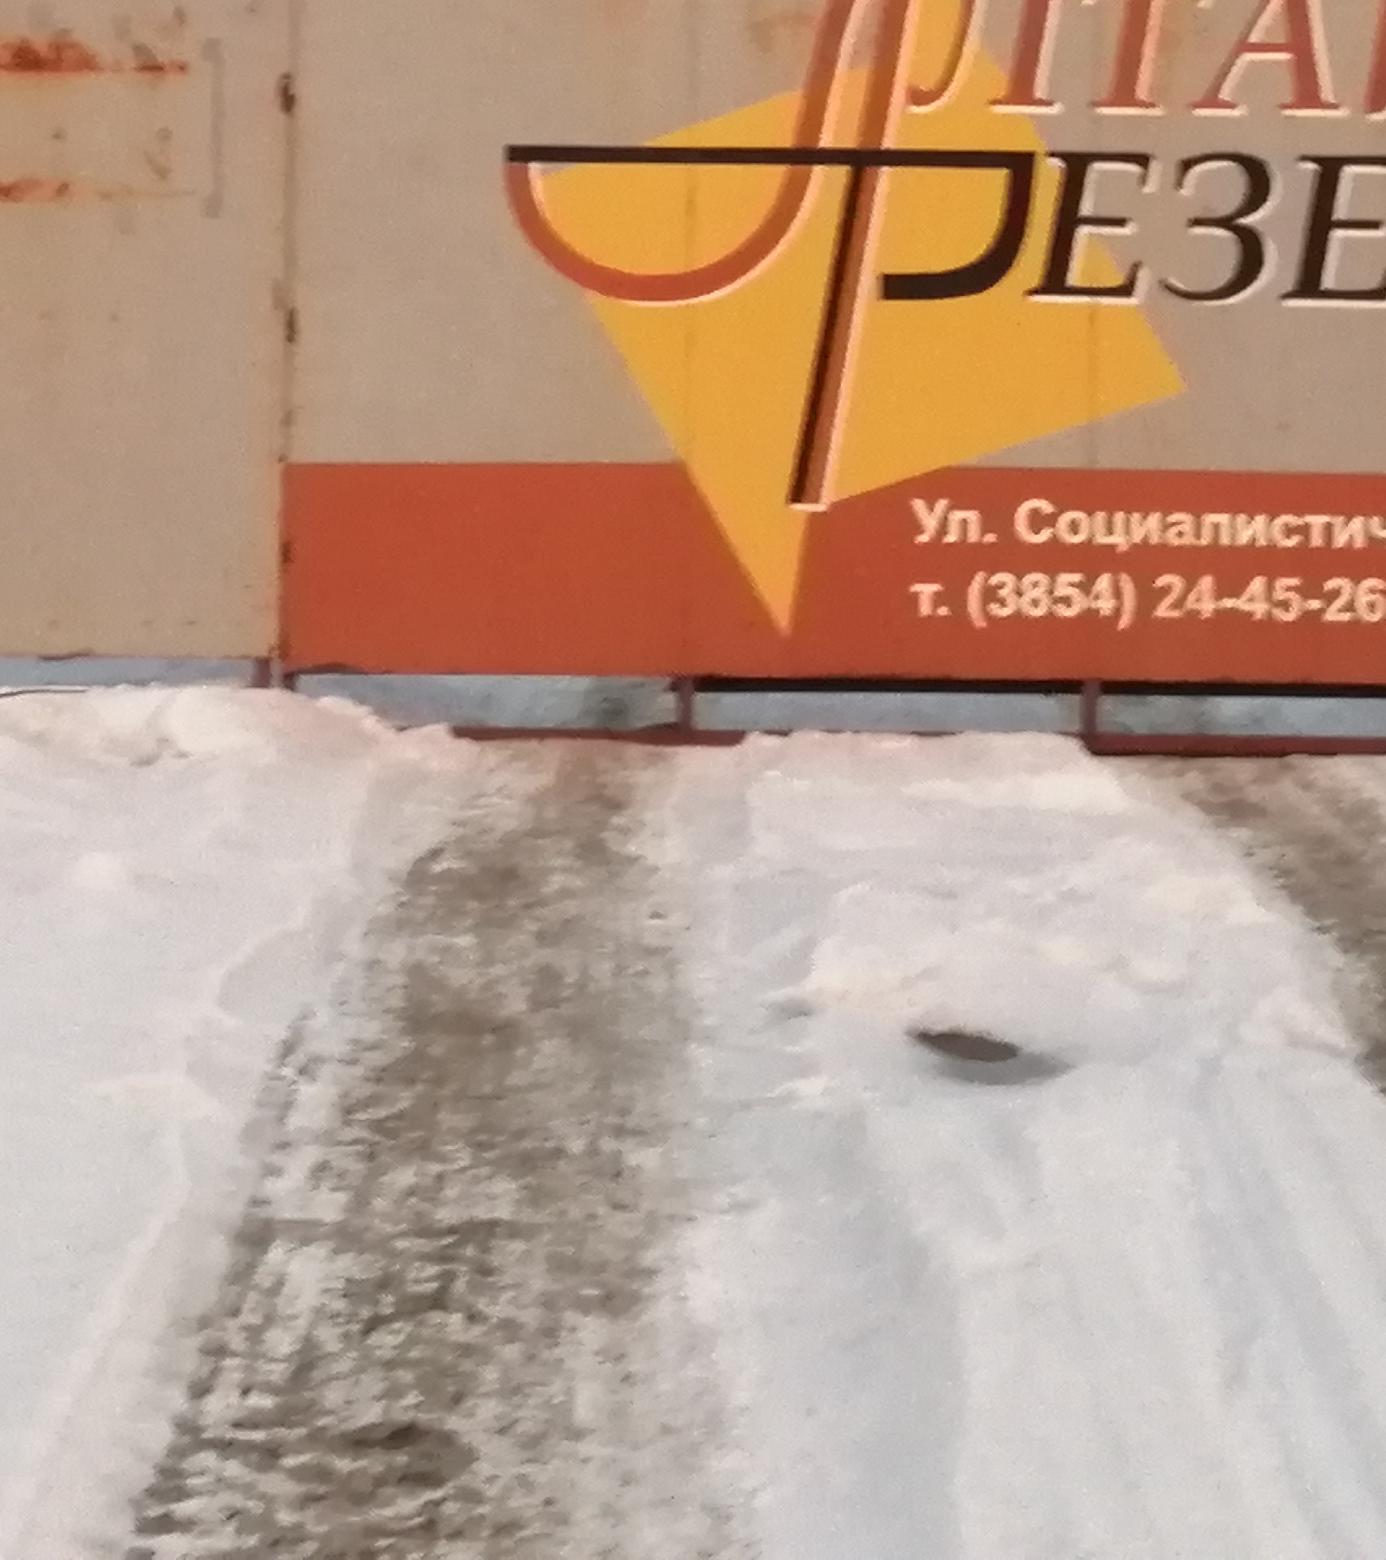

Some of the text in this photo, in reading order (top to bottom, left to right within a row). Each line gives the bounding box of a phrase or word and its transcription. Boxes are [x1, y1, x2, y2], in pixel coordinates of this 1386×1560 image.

[911, 498, 998, 544] Ул.
[910, 582, 951, 617] т.
[966, 571, 1137, 630] (3854)
